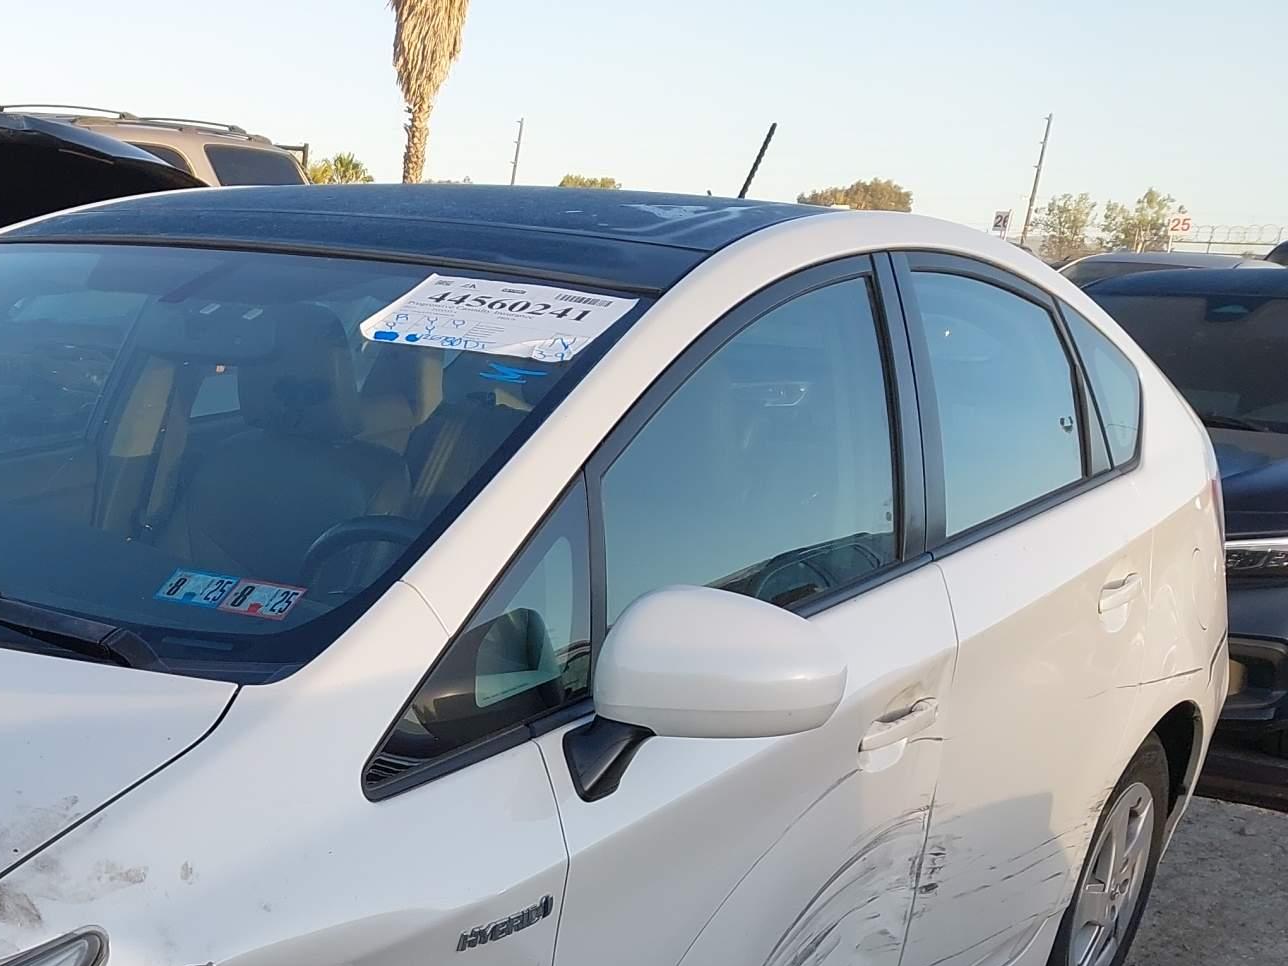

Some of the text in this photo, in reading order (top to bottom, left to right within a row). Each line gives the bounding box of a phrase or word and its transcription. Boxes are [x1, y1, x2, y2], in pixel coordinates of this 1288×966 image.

[1170, 218, 1191, 231] 25
[429, 291, 593, 322] 44560241
[167, 577, 187, 596] 8
[230, 586, 255, 607] 8
[456, 896, 553, 952] HYBRID
